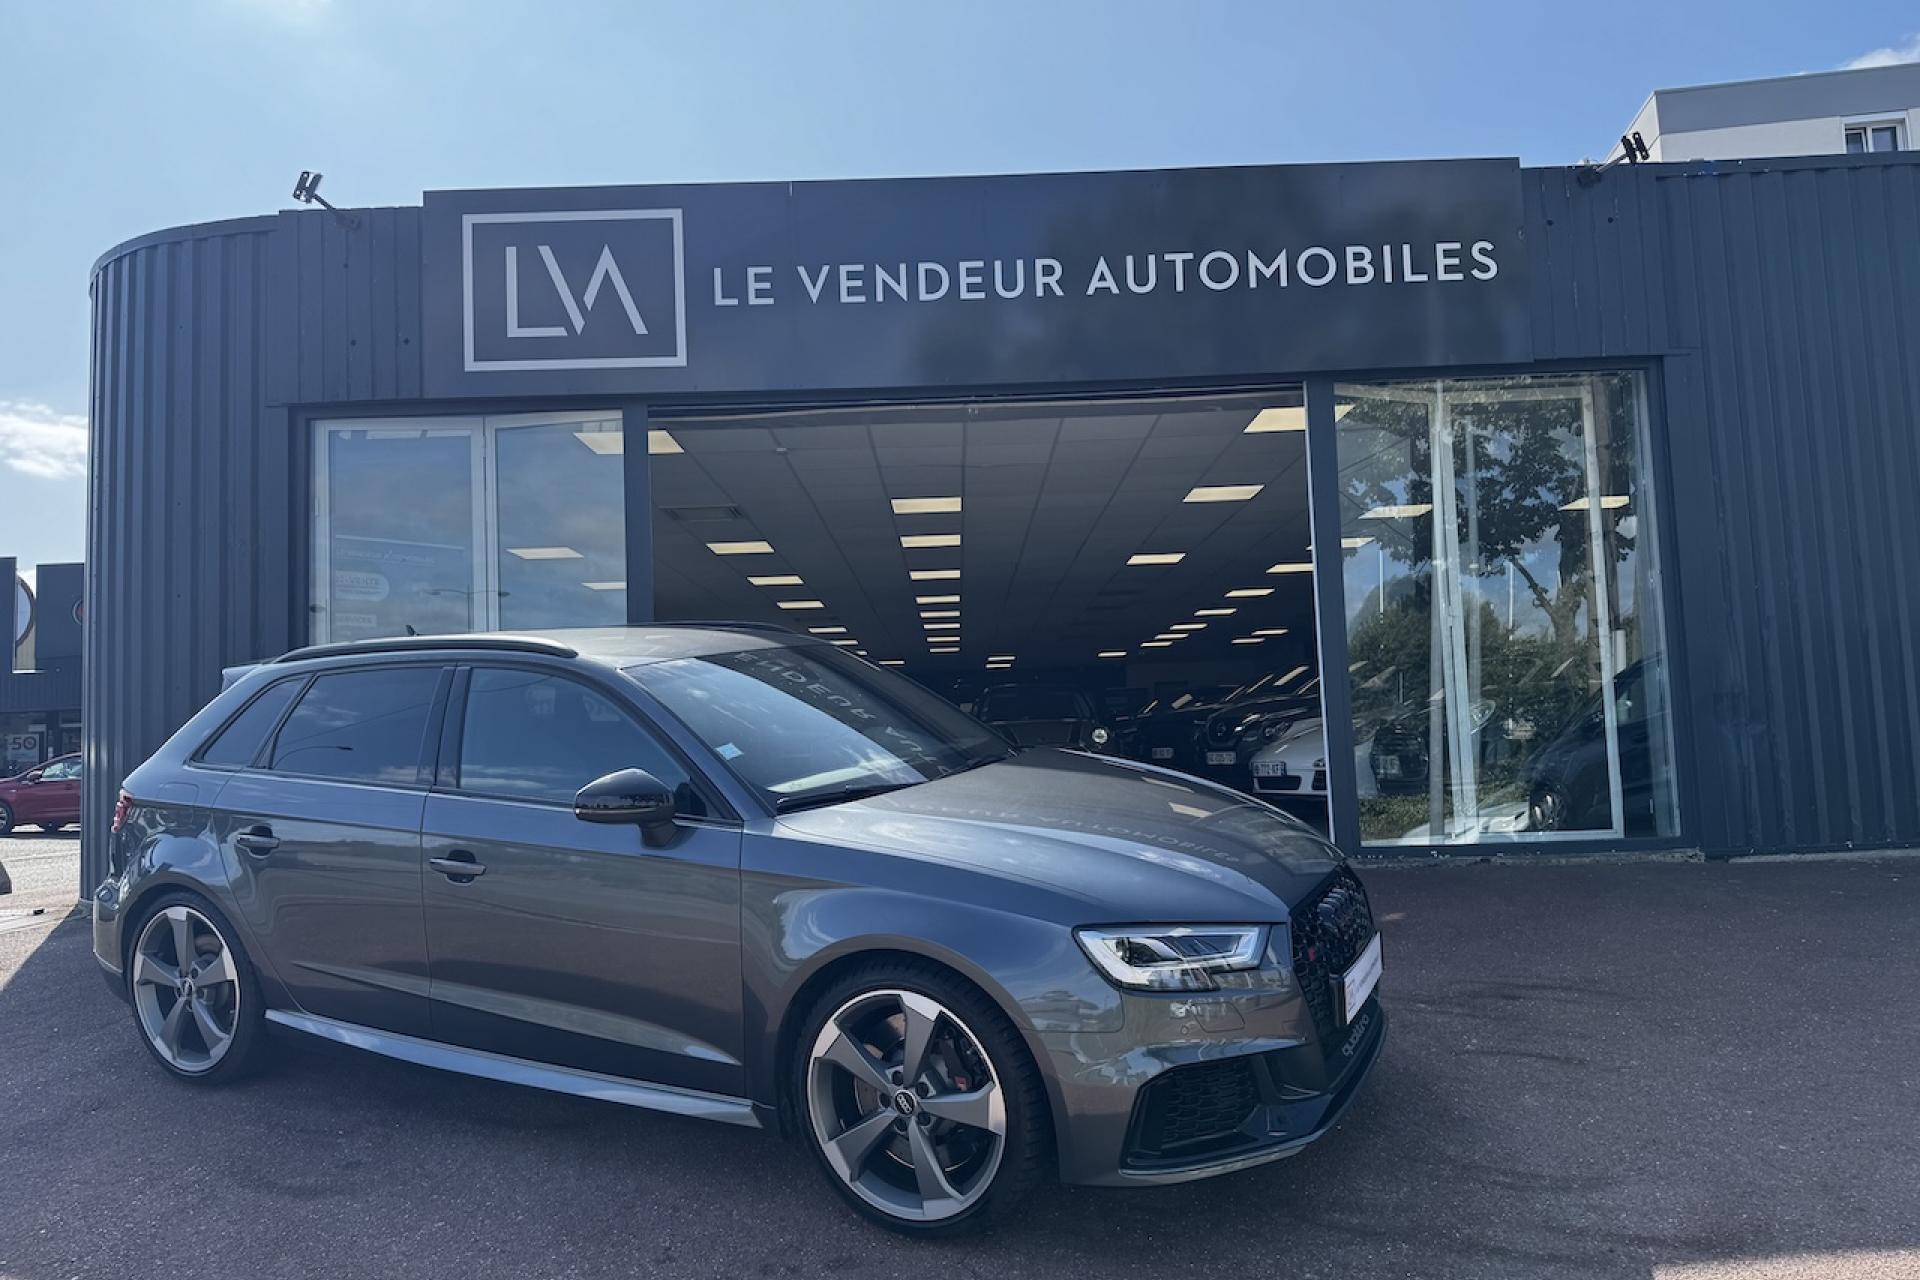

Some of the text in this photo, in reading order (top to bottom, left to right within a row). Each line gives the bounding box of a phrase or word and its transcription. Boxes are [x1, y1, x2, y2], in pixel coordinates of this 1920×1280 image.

[713, 240, 1499, 307] LE VENDEUR AUTOMOBILES
[1341, 1013, 1370, 1058] quattro
